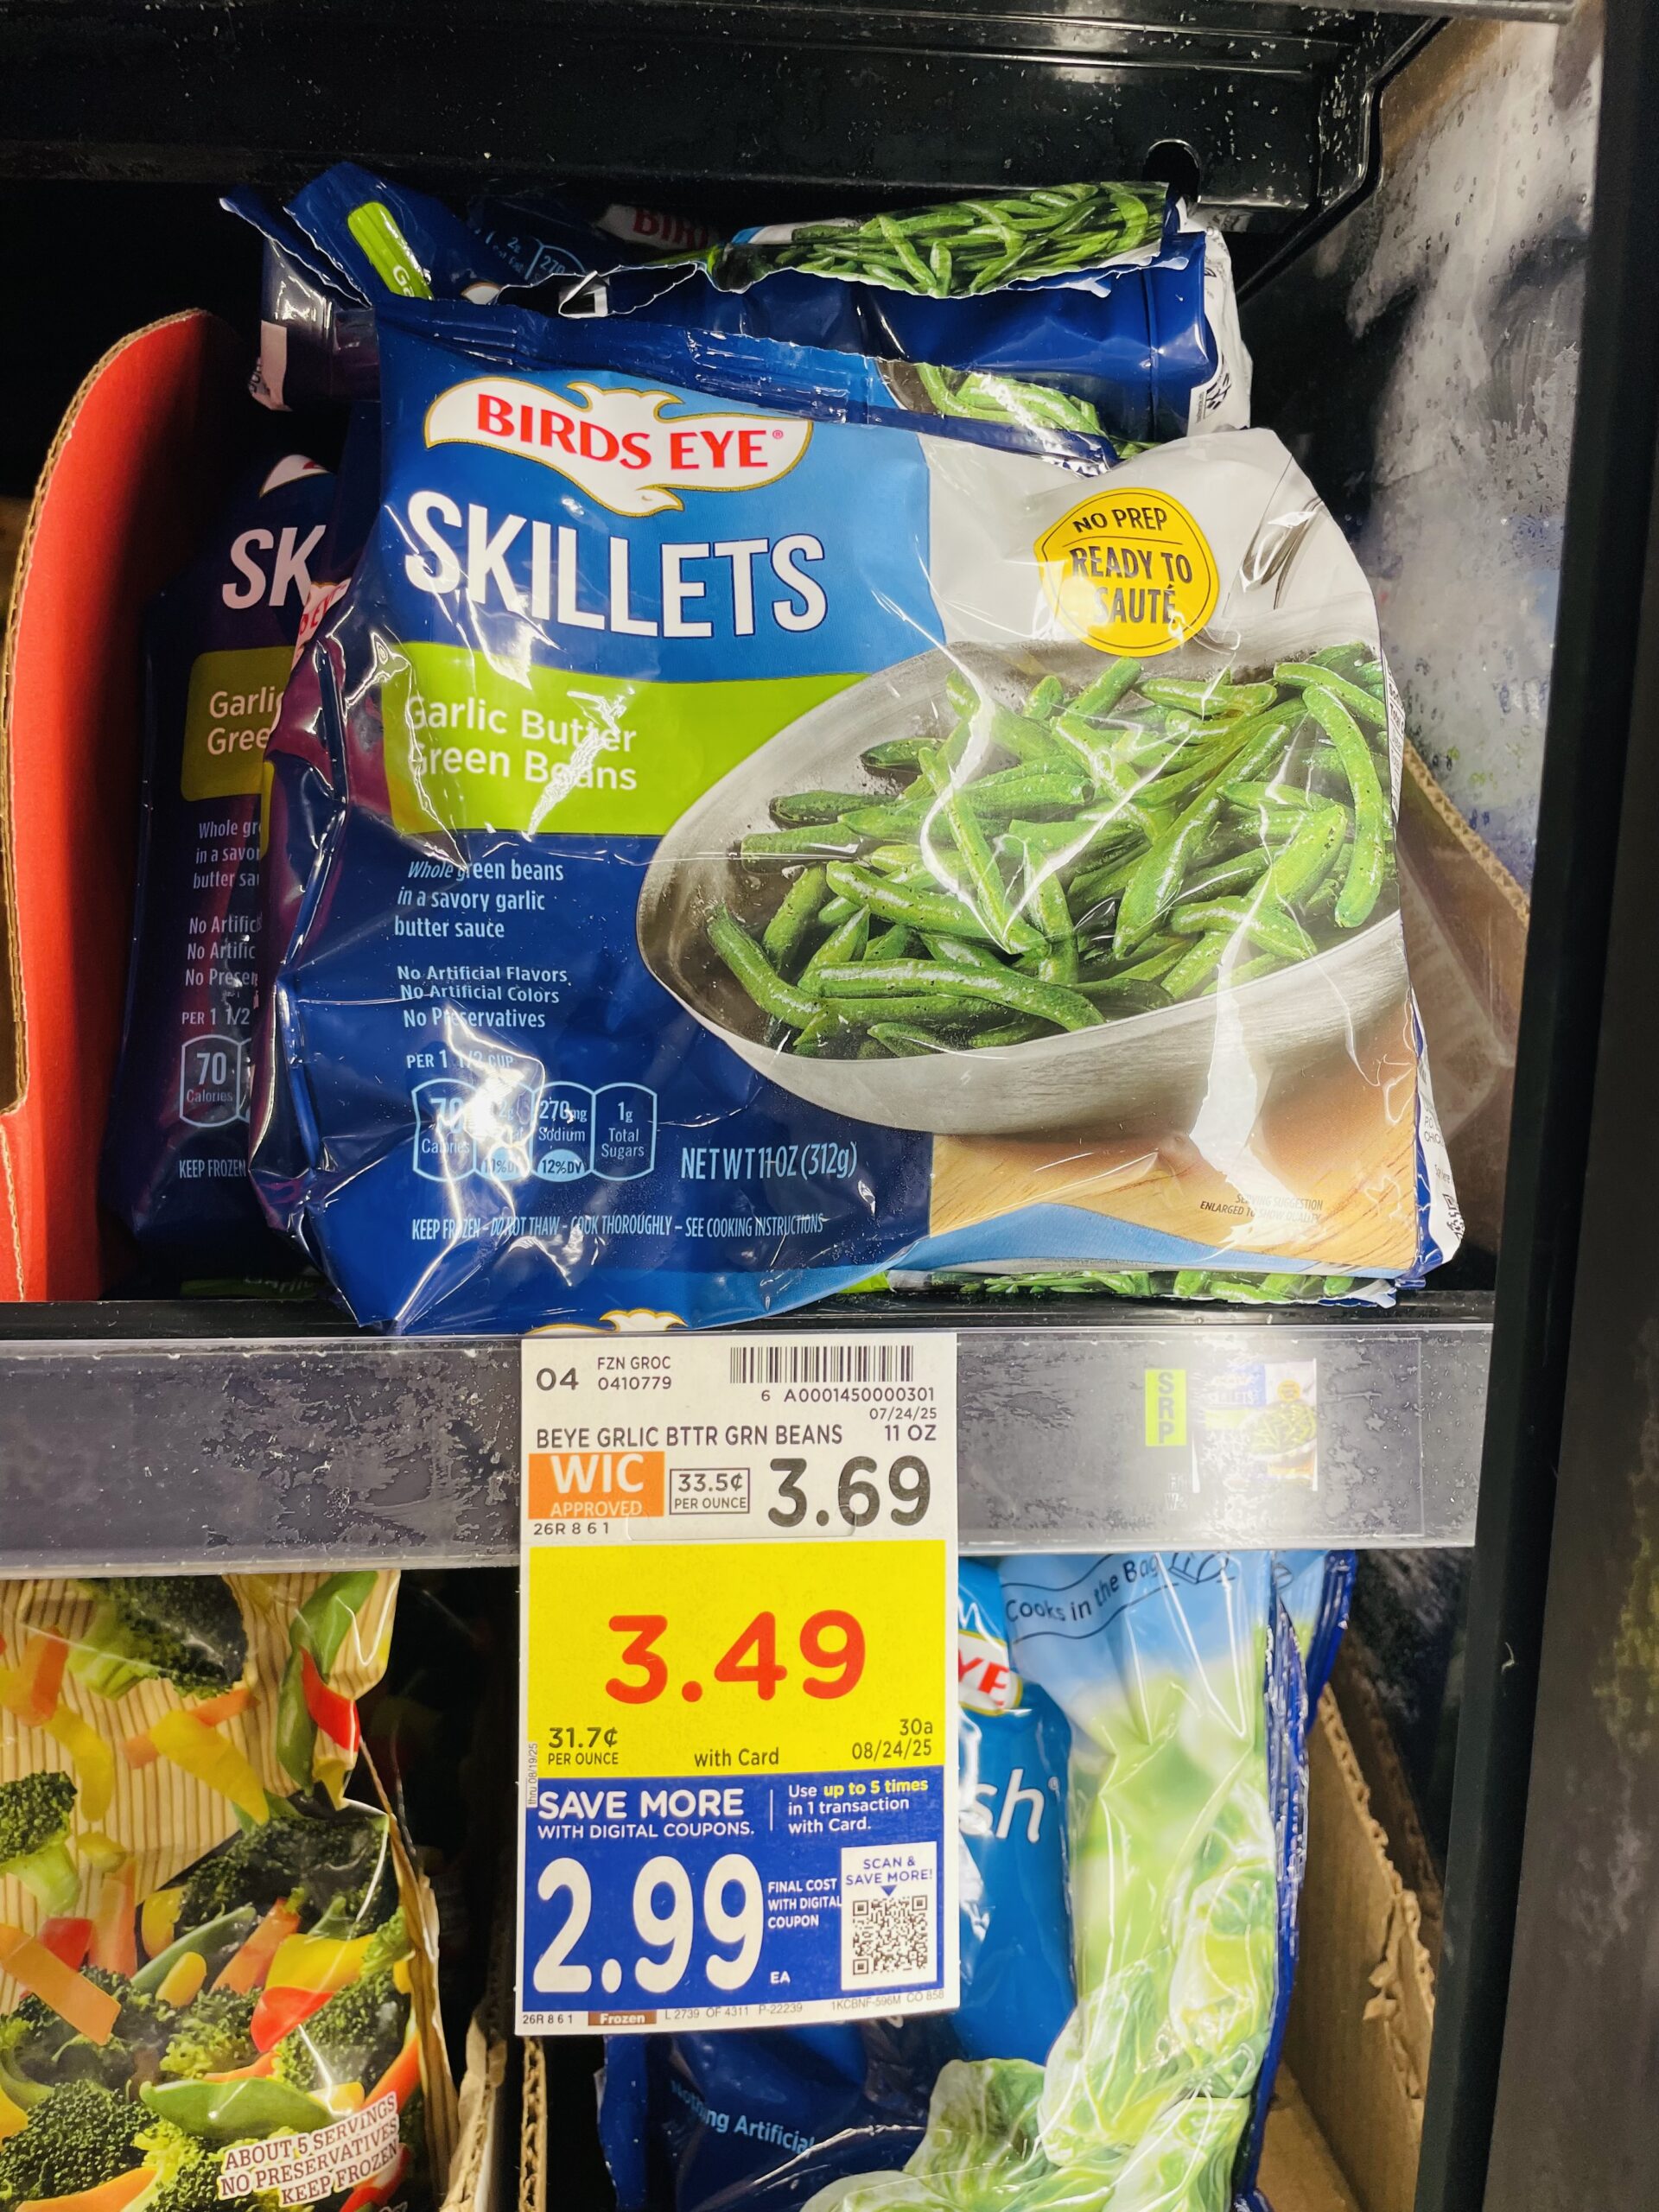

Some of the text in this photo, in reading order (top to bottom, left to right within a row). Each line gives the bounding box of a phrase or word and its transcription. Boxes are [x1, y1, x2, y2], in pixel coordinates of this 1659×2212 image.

[477, 393, 769, 471] BIRDS EYE
[1072, 507, 1167, 533] NO PREP
[222, 524, 327, 609] SK
[404, 491, 828, 639] SKILLETS
[1069, 546, 1192, 584] READY TO
[1094, 584, 1177, 625] SAUTÉ
[406, 696, 508, 734] Garlic
[207, 727, 270, 755] Gree
[408, 742, 512, 778] Green
[199, 819, 238, 839] Whole
[195, 848, 207, 864] in
[211, 849, 219, 862] a
[408, 858, 564, 882] Whole green beans
[193, 872, 235, 890] butter
[397, 887, 545, 912] in a savory garlic
[189, 917, 207, 934] No
[394, 915, 505, 938] butter sauce
[188, 943, 205, 960] No
[185, 969, 204, 987] No
[397, 965, 568, 982] No Artificial Flavors
[400, 984, 560, 1004] No Artificial Colors
[181, 1011, 205, 1026] PER
[403, 1009, 427, 1027] No
[196, 1052, 227, 1085] 70
[406, 1052, 435, 1069] PER
[439, 1049, 448, 1068] 1
[186, 1089, 233, 1103] Calories
[617, 1102, 634, 1123] 1g
[538, 1127, 586, 1142] Sodium
[608, 1128, 639, 1142] Total
[422, 1138, 471, 1154] Calories
[601, 1143, 645, 1160] Sugars
[178, 1159, 248, 1179] KEEP FROZEN
[541, 1159, 585, 1175] 12%DV
[681, 1141, 859, 1181] NET WT (312g)
[1199, 1200, 1244, 1216] ENLARGED
[411, 1218, 440, 1241] KEEP
[529, 1217, 561, 1236] THAW
[570, 1215, 600, 1236] COOK
[601, 1213, 673, 1236] THOROUGHLY
[685, 1217, 704, 1237] SEE
[707, 1217, 753, 1237] COOKING
[754, 1213, 824, 1237] INSTRUCTIONS
[537, 1356, 671, 1391] 04 FZN GROC
[598, 1376, 671, 1390] 0410779
[761, 1387, 934, 1402] 6 A0001450000301
[869, 1406, 938, 1421] 07/24/25
[537, 1424, 937, 1448] BEYE GRLIC BTTR GRN BEANS 11 OZ
[550, 1452, 645, 1494] WIC
[678, 1472, 743, 1492] 33.5¢
[768, 1455, 931, 1527] 3.69
[550, 1500, 643, 1517] APPROVED
[675, 1497, 747, 1510] PER OUNCE
[533, 1522, 565, 1535] 26R
[1005, 1599, 1065, 1623] Cooks
[1071, 1599, 1092, 1620] in
[1093, 1575, 1121, 1607] the
[606, 1610, 866, 1705] 3.49
[549, 1718, 934, 1748] 31.7¢ 30a
[548, 1738, 933, 1768] PER OUNCE with Card 08/24/25
[528, 1743, 538, 1806] thru 08/19/25
[788, 1777, 929, 1799] Use up to 5 times
[538, 1788, 745, 1821] SAVE MORE
[788, 1797, 910, 1816] in 1 transaction
[537, 1821, 754, 1839] WITH DIGITAL COUPONS.
[788, 1816, 872, 1834] with Card.
[863, 1855, 916, 1871] SCAN &
[767, 1878, 837, 1894] FINAL COST
[845, 1869, 933, 1886] SAVE MORE!
[767, 1895, 842, 1911] WITH DIGITAL
[533, 1853, 765, 1994] 2.99
[767, 1914, 819, 1929] COUPON
[770, 1971, 791, 1985] EA
[523, 2013, 545, 2025] 26R
[600, 2012, 646, 2024] Frozen
[674, 2009, 701, 2019] 2739
[706, 2007, 722, 2018] OF
[724, 2005, 749, 2017] 4311
[759, 2002, 803, 2015] P-22239
[906, 1991, 924, 2004] CO
[926, 1989, 945, 2001] 858
[226, 2094, 397, 2171] ABOUT 5 SERVINGS
[221, 2117, 398, 2196] NO PRESERVATIVES
[282, 2138, 398, 2205] KEEP FROZEN
